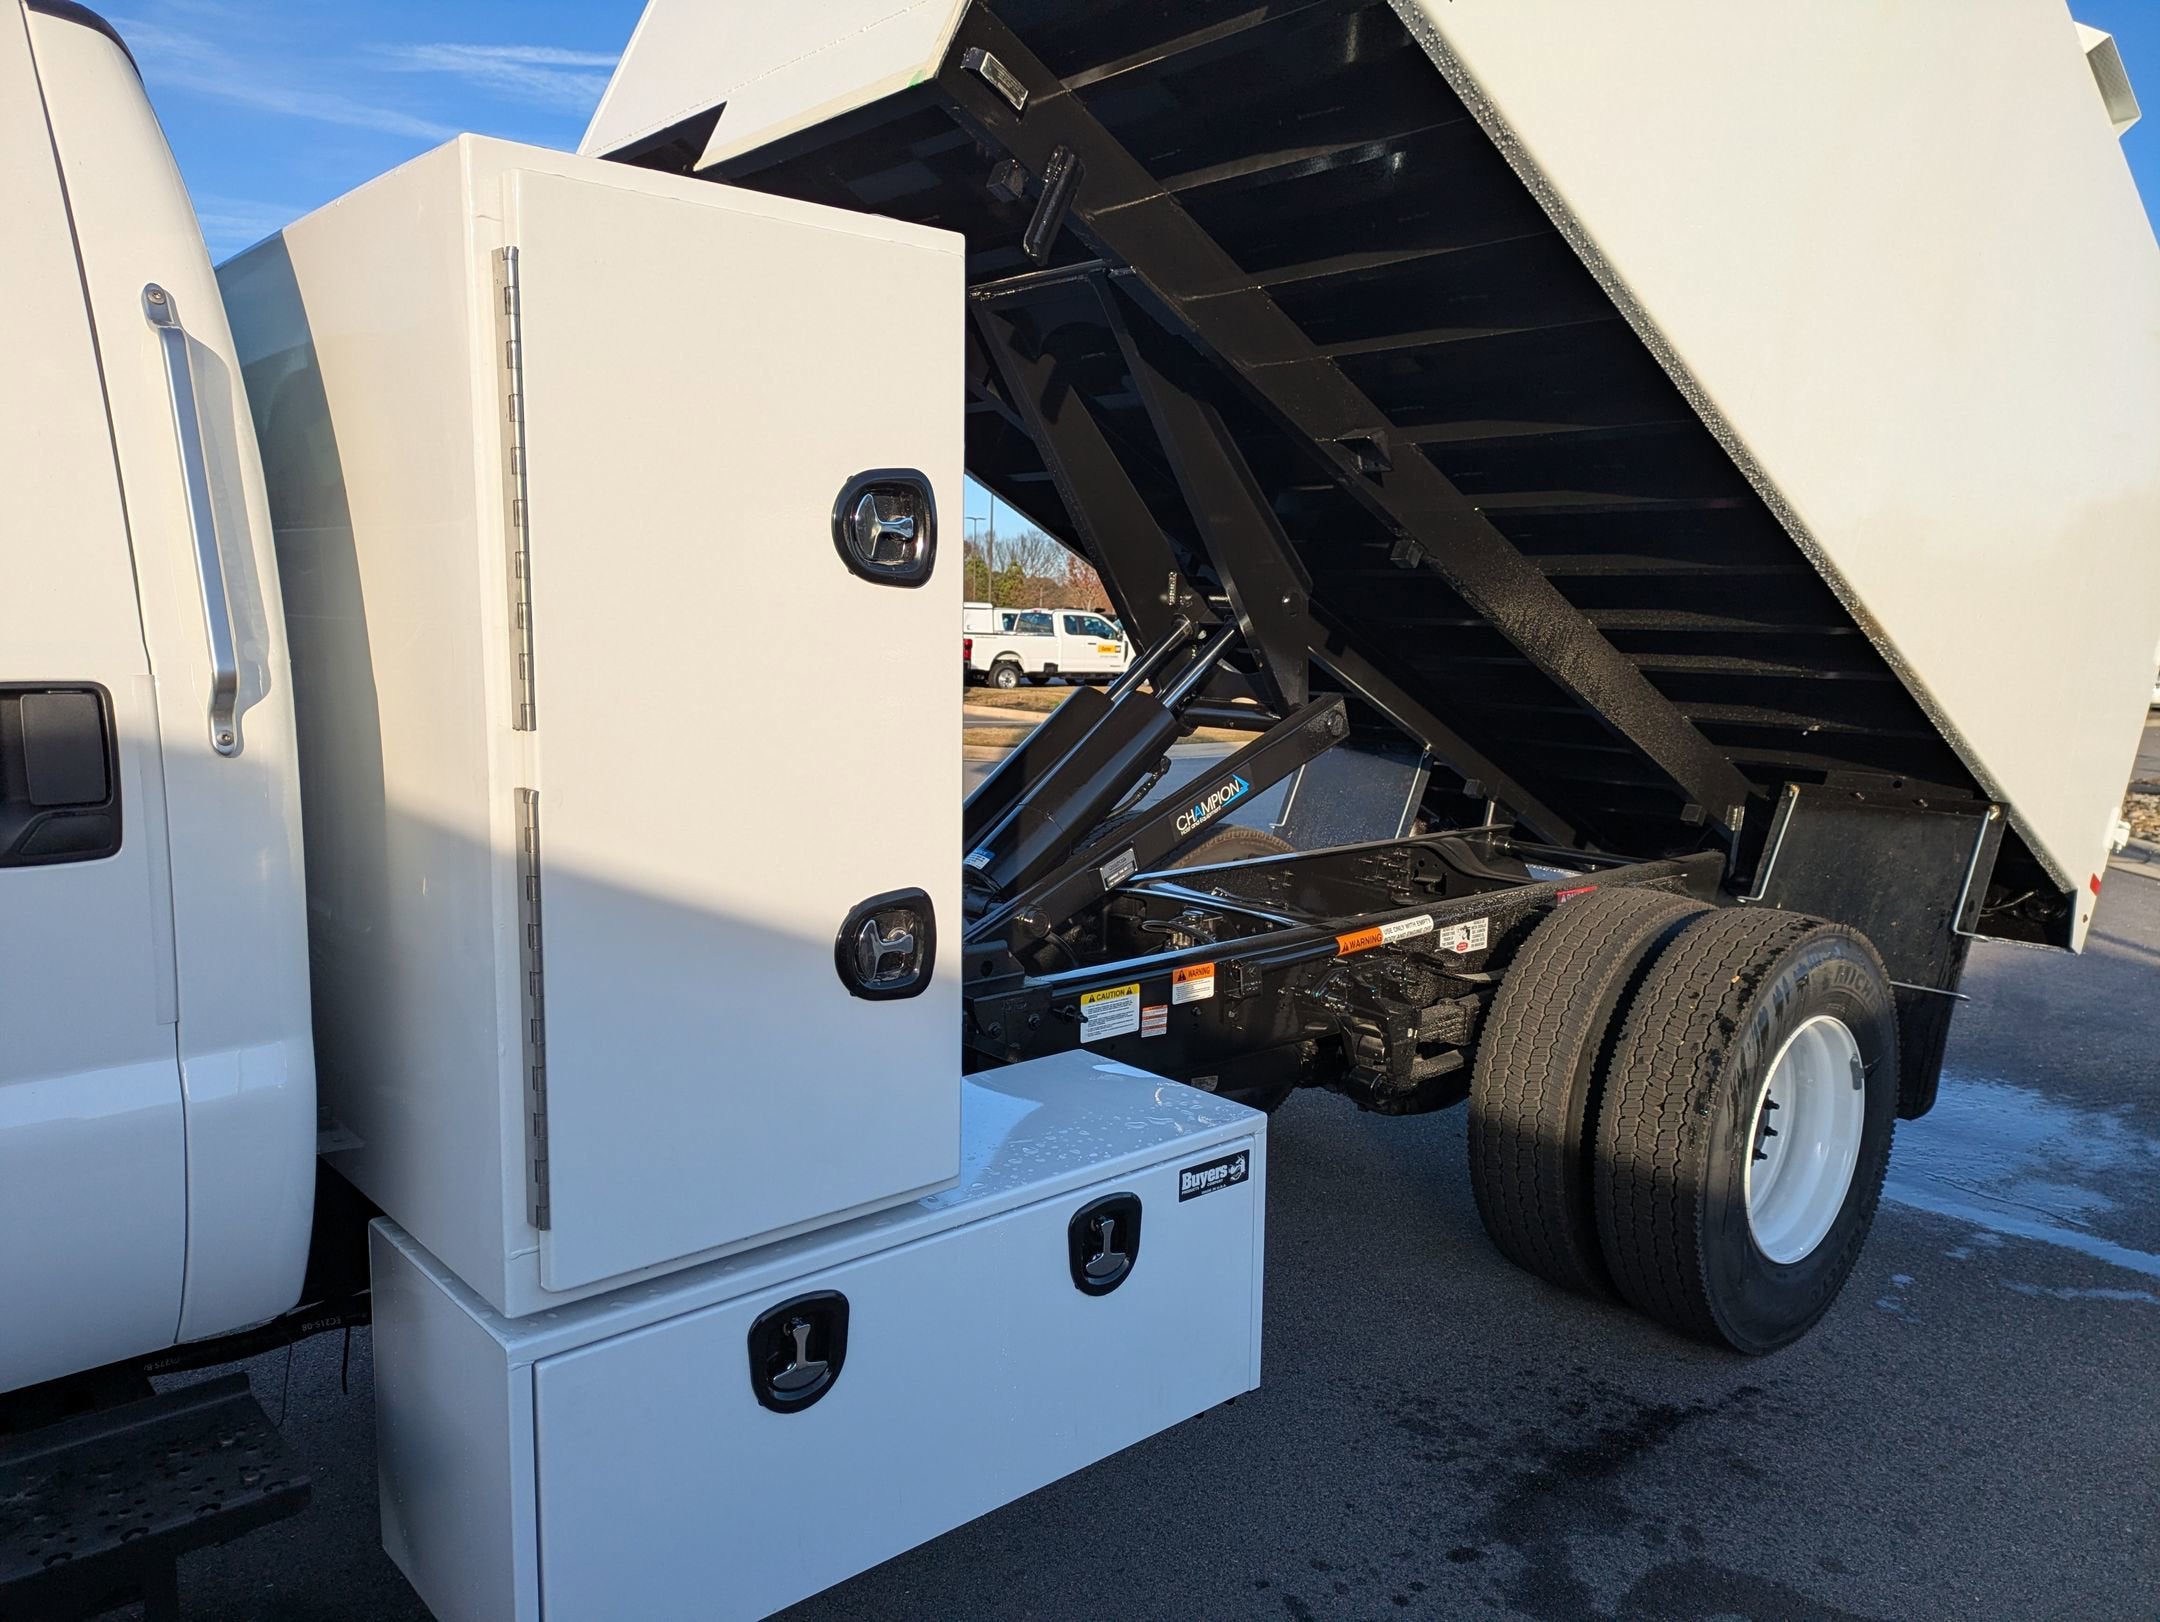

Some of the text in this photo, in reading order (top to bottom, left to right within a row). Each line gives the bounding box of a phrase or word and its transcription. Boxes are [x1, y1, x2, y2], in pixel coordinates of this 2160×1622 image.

[1176, 779, 1240, 831] CHAMPION
[1393, 924, 1404, 932] ONLY
[1405, 921, 1416, 929] WITH
[1416, 918, 1431, 926] EMPTY
[1350, 934, 1382, 949] WARNING
[1188, 966, 1211, 978] WARNING
[1096, 989, 1125, 1001] CAUTION
[1181, 1164, 1228, 1189] Buyers
